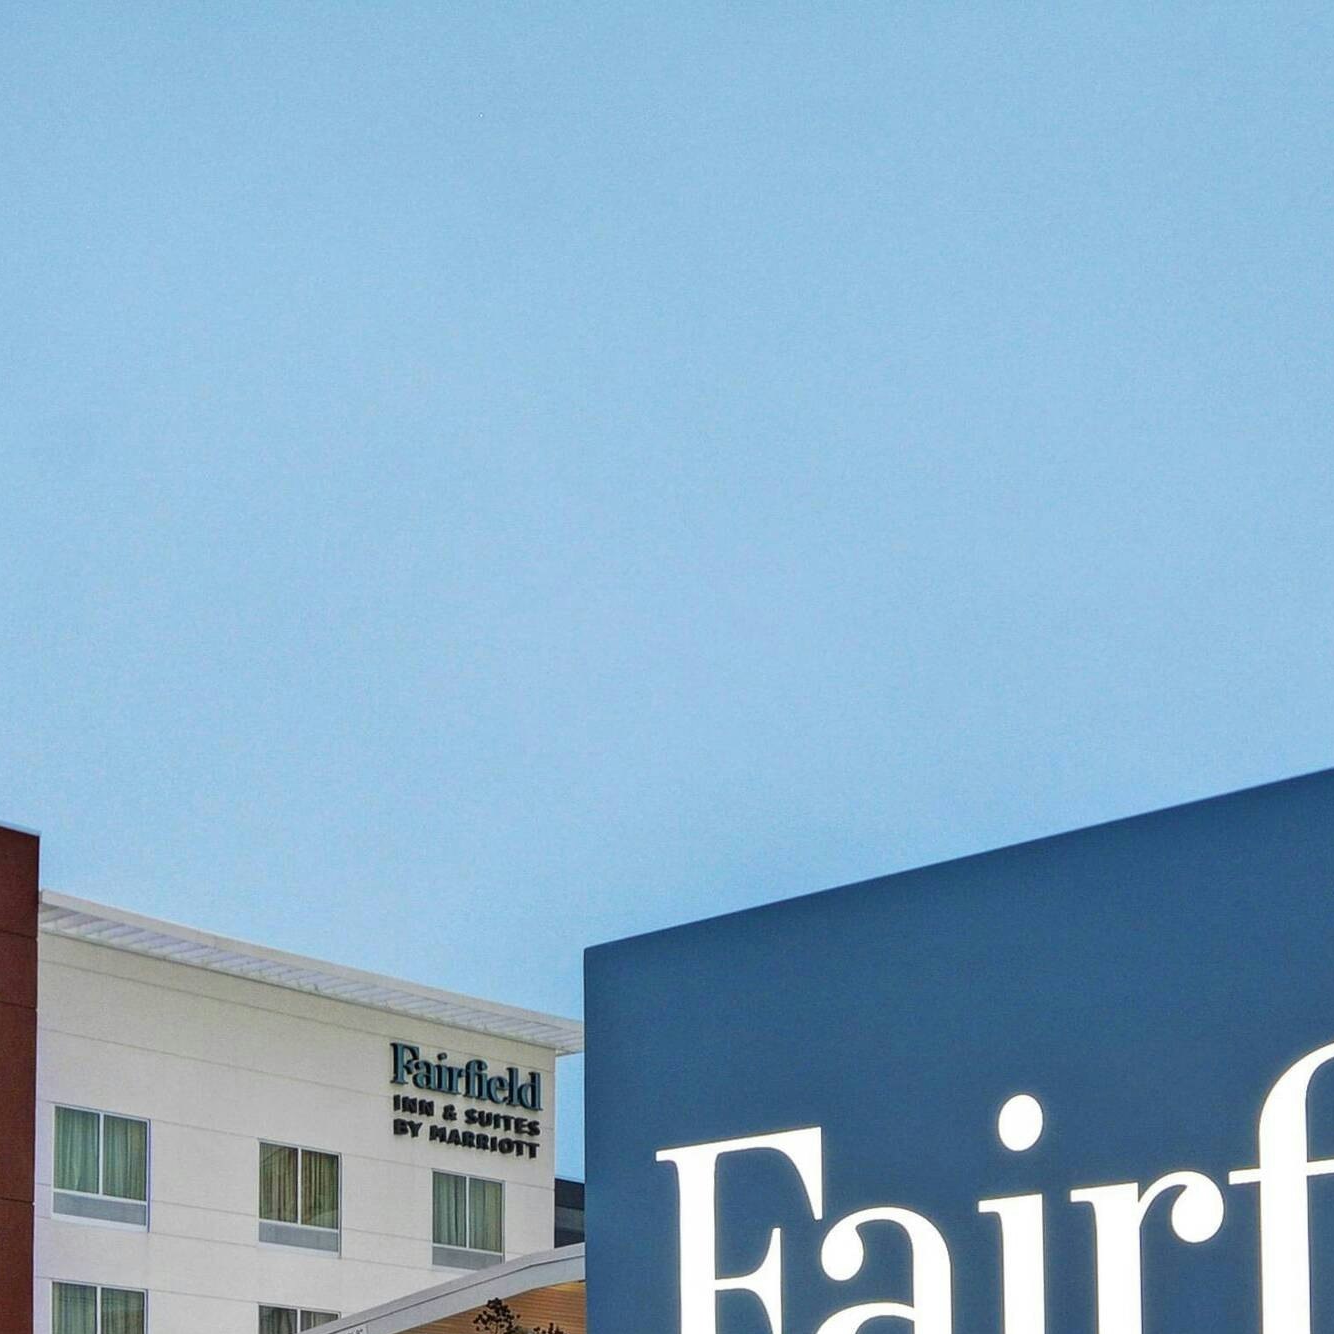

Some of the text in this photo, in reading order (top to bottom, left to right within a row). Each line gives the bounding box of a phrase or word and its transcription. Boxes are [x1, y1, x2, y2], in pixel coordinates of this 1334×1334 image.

[389, 1042, 544, 1112] Fairfield
[392, 1094, 541, 1138] INN & SUITES
[392, 1118, 541, 1160] BY MARRIOTT
